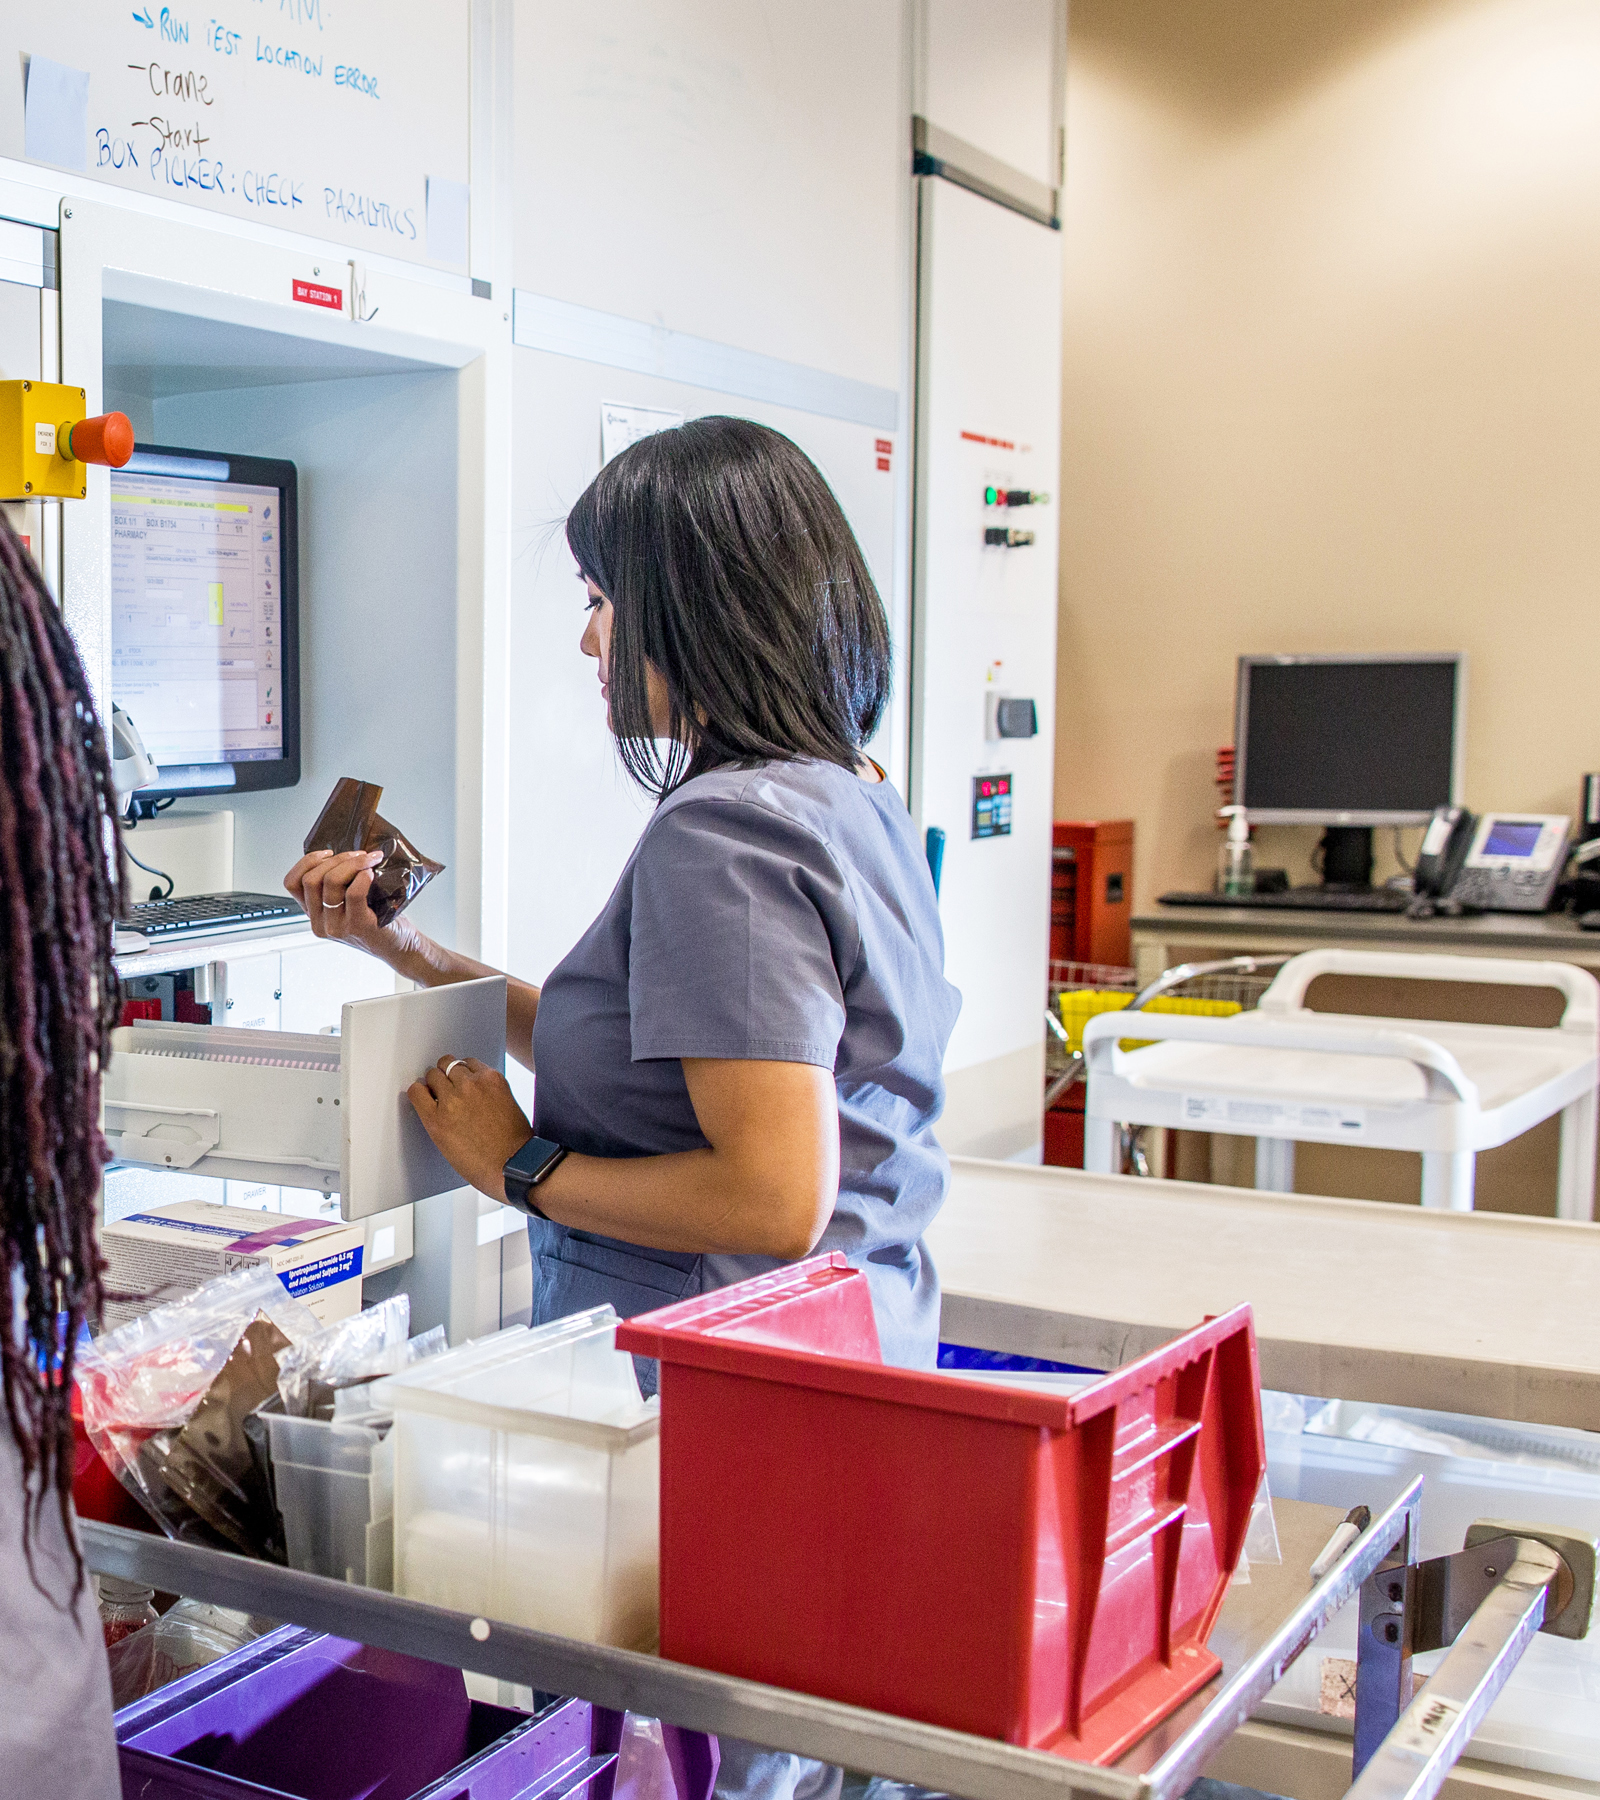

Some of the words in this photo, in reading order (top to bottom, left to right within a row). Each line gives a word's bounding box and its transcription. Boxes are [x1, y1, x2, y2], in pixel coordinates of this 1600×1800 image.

[160, 7, 189, 43] RUN
[207, 19, 242, 55] TEST
[256, 36, 323, 77] LOCATION
[334, 65, 380, 100] ERROR
[243, 170, 304, 209] CHECK
[297, 286, 307, 296] BAY
[309, 289, 332, 303] STATION
[333, 295, 338, 303] 1
[114, 516, 127, 526] BOX
[146, 519, 159, 527] BOX
[114, 529, 147, 539] PHARMACY
[244, 1186, 266, 1200] DRAWER
[288, 1264, 318, 1280] Ipratropium
[318, 1255, 338, 1269] Bromide
[338, 1253, 346, 1262] 0.5
[346, 1251, 354, 1260] mg
[288, 1280, 299, 1289] and
[299, 1271, 322, 1286] Albuterol
[322, 1266, 339, 1278] Sulfate
[289, 1286, 308, 1298] nhalation
[308, 1281, 325, 1291] Solution
